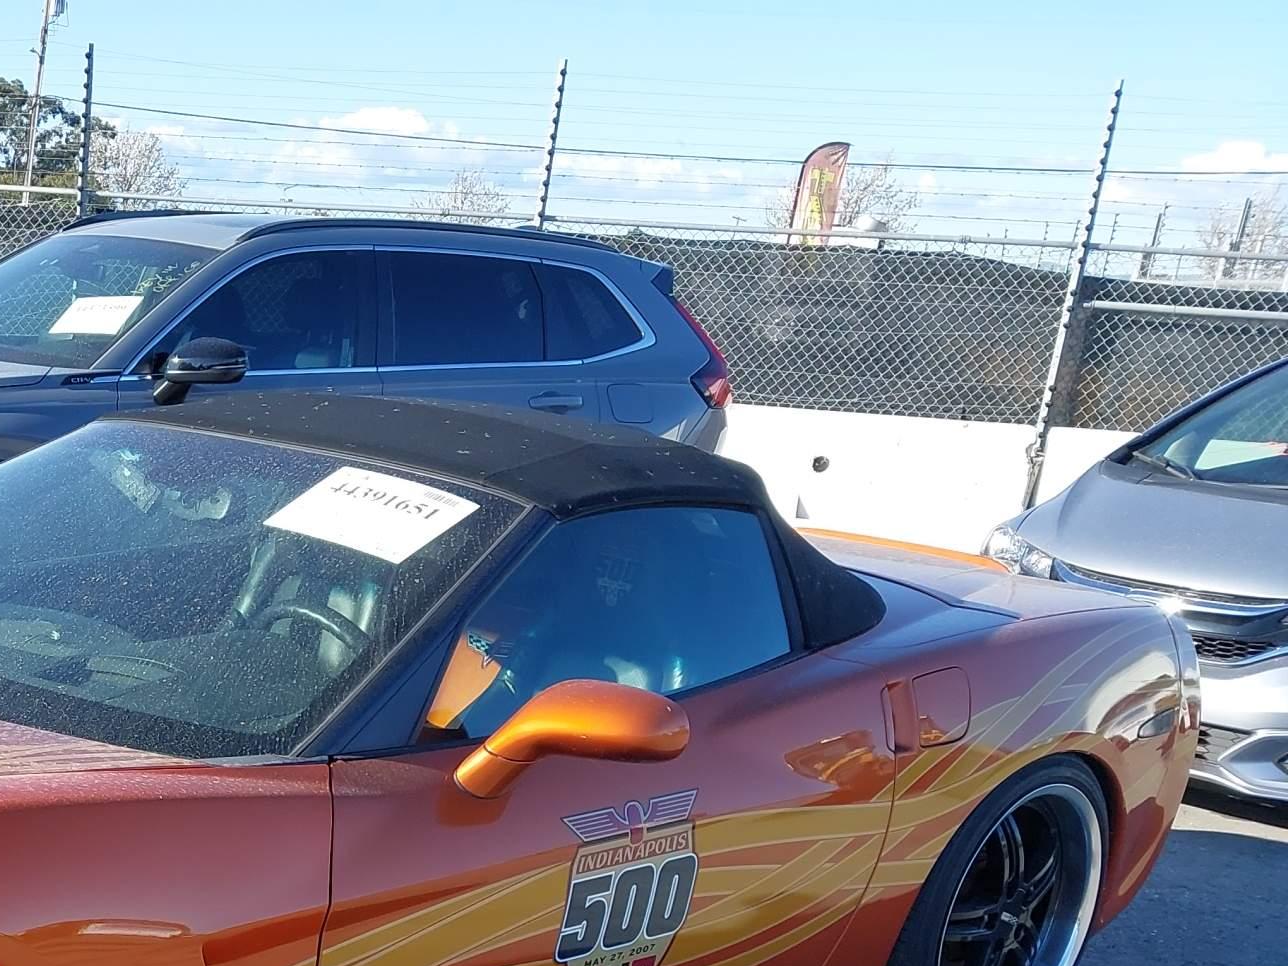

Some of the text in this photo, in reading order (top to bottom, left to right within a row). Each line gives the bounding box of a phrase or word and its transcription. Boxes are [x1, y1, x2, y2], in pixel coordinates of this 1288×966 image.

[331, 482, 441, 520] 44391651
[578, 832, 688, 873] INDIANAPOLIS
[555, 853, 698, 963] 500
[610, 951, 625, 961] 27,
[629, 943, 656, 957] 2007
